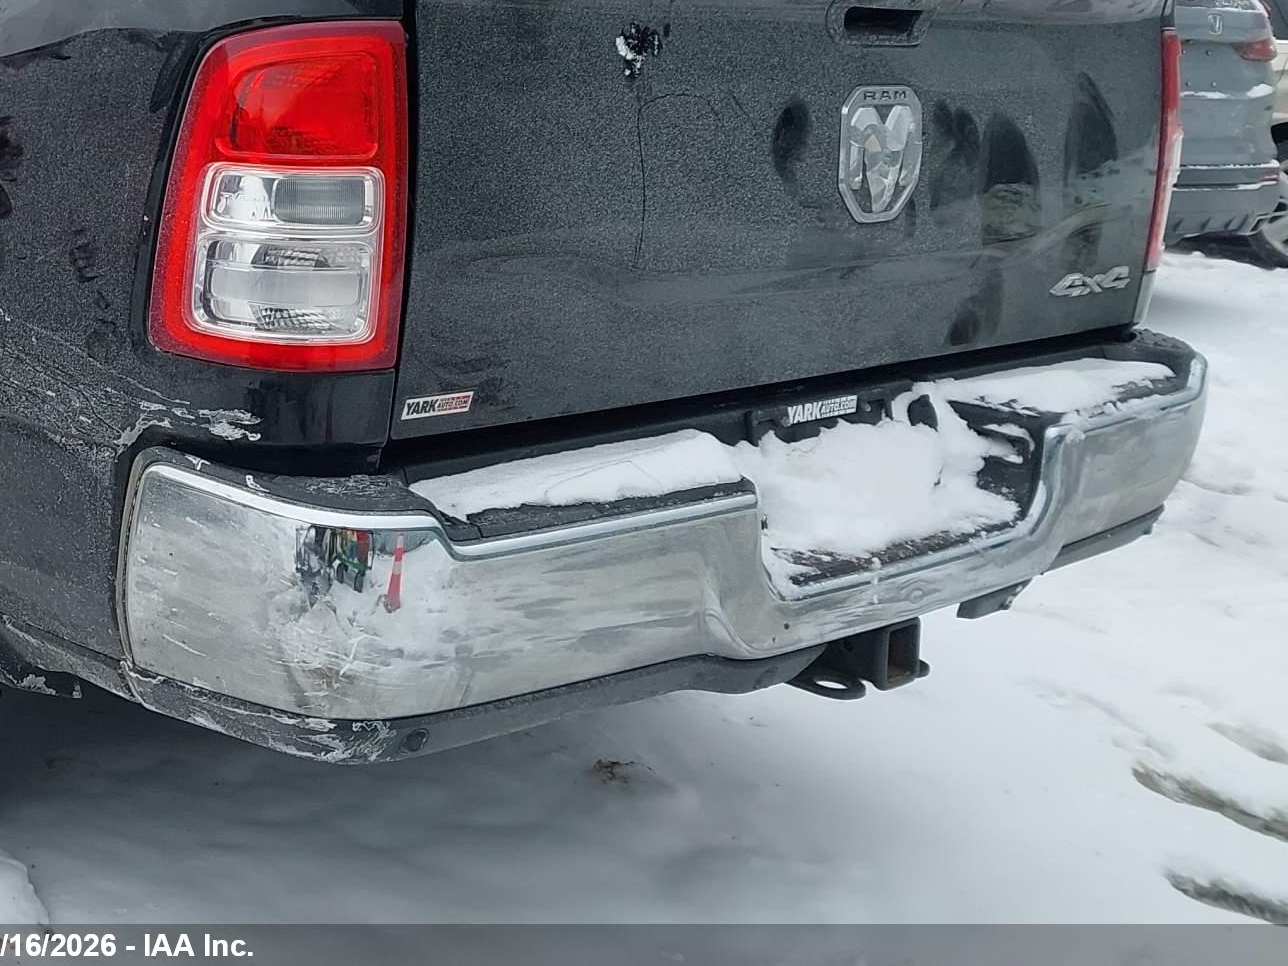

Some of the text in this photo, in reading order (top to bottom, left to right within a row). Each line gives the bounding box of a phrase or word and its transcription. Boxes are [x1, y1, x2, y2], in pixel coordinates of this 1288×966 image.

[863, 90, 907, 101] RAM
[405, 399, 440, 416] YARK
[787, 401, 822, 424] YARK
